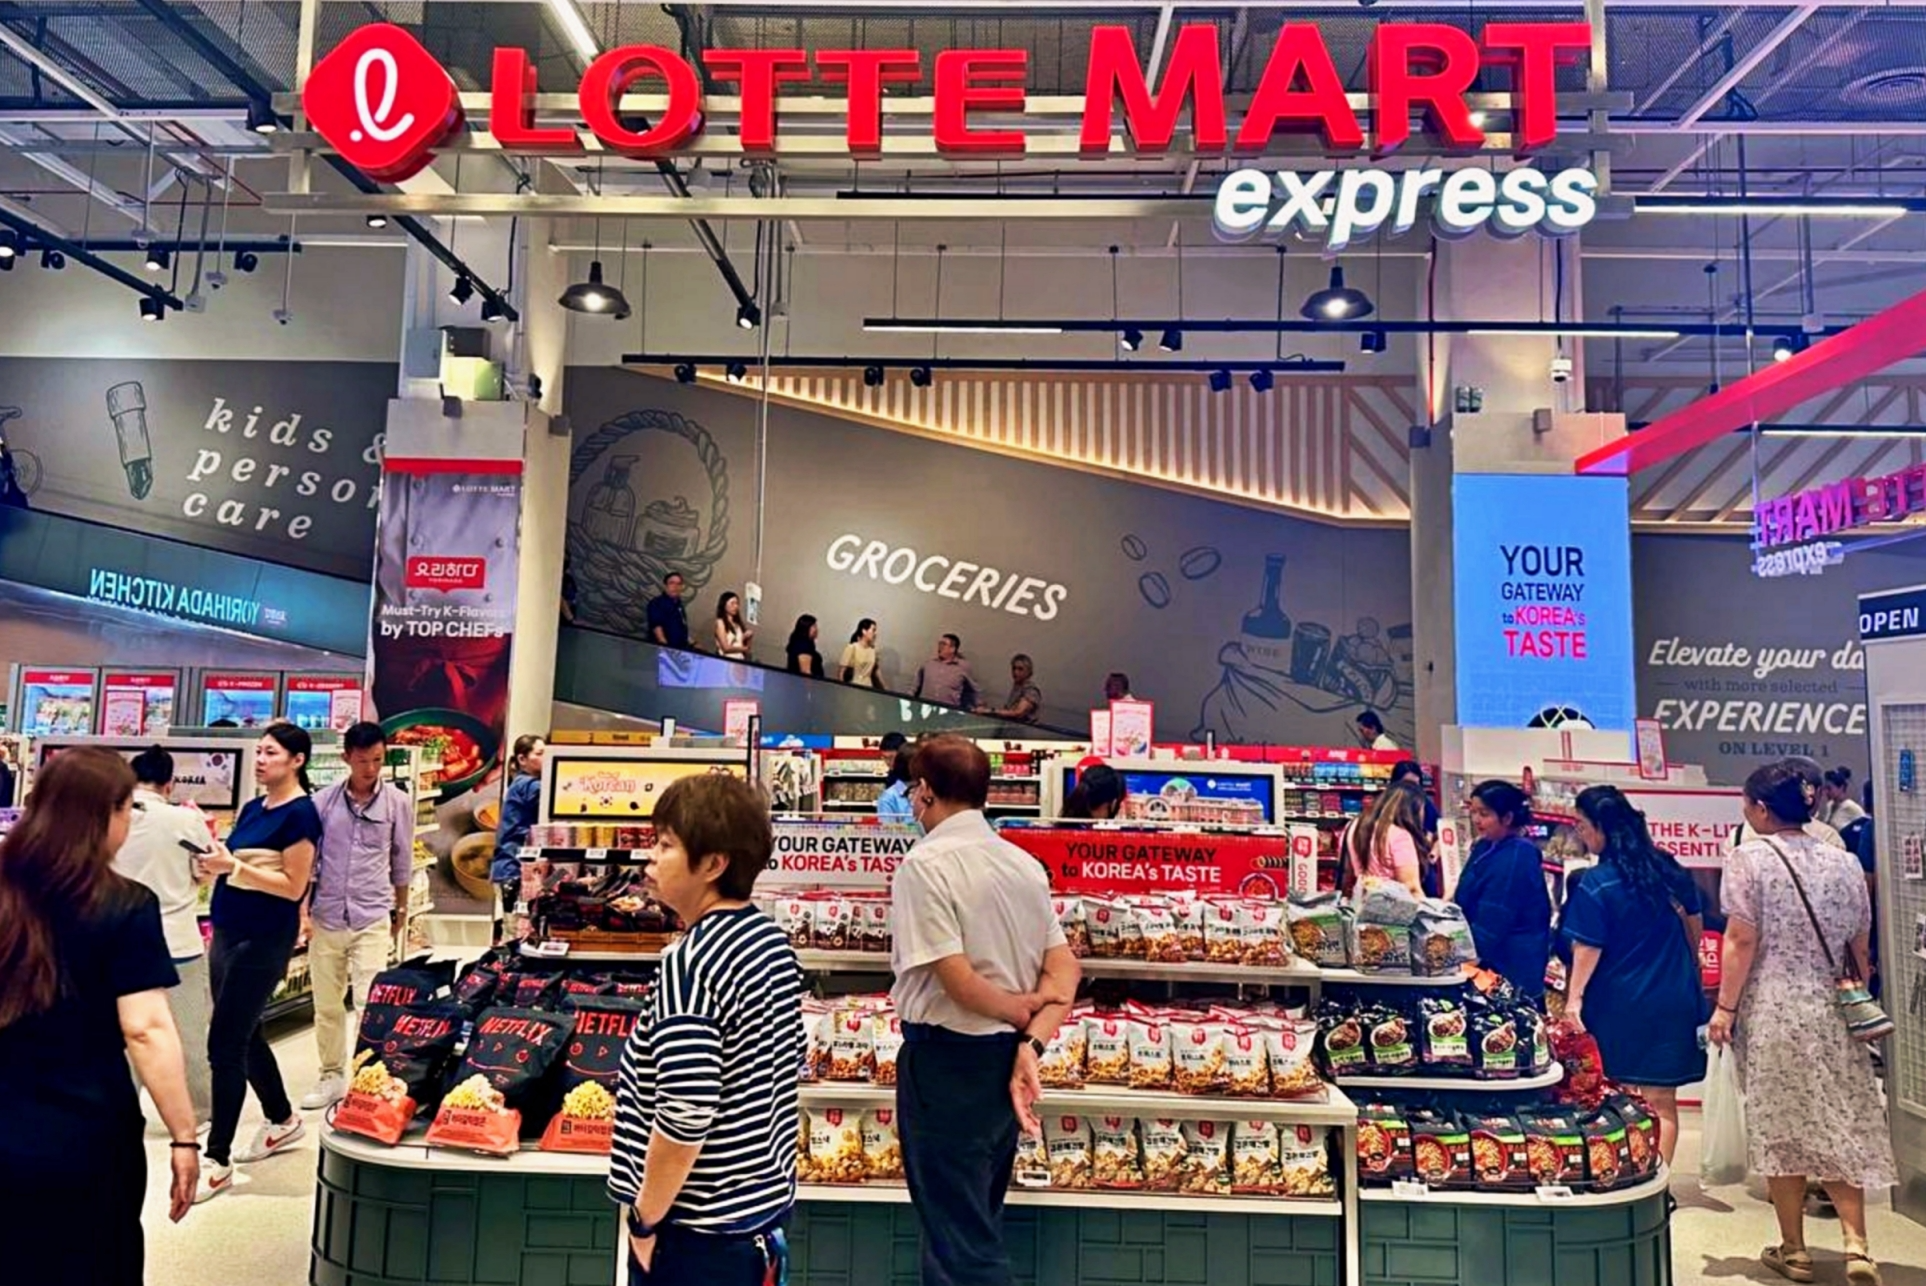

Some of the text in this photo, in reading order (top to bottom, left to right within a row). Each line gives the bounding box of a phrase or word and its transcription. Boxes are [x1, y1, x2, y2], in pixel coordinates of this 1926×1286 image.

[490, 22, 1592, 155] LOTTE MART
[1214, 167, 1598, 250] express
[205, 398, 333, 453] kids
[490, 485, 515, 493] MART
[183, 493, 313, 539] care
[415, 562, 479, 577] 요리하다
[1500, 545, 1585, 577] YOUR
[827, 534, 1067, 620] GROCERIES
[1502, 582, 1584, 601] GATEWAY
[381, 604, 442, 618] Must-Try
[1503, 612, 1514, 624] to
[1859, 607, 1919, 633] OPEN
[381, 620, 403, 639] by
[406, 621, 443, 636] TOP
[1503, 630, 1587, 658] TASTE
[1648, 637, 1751, 667] Elevate
[1753, 648, 1826, 679] your
[1684, 677, 1838, 693] with more selected
[1655, 700, 1866, 734] EXPERIENCE
[1719, 741, 1828, 757] ON LEVEL 1
[1647, 822, 1684, 837] THE
[773, 836, 916, 854] OUR GATEWAY
[1065, 842, 1217, 863] YOUR GATEWAY
[782, 855, 858, 872] KOREA's
[1062, 862, 1222, 883] to KOREA's TASTE
[479, 1016, 552, 1046] NETFLIX
